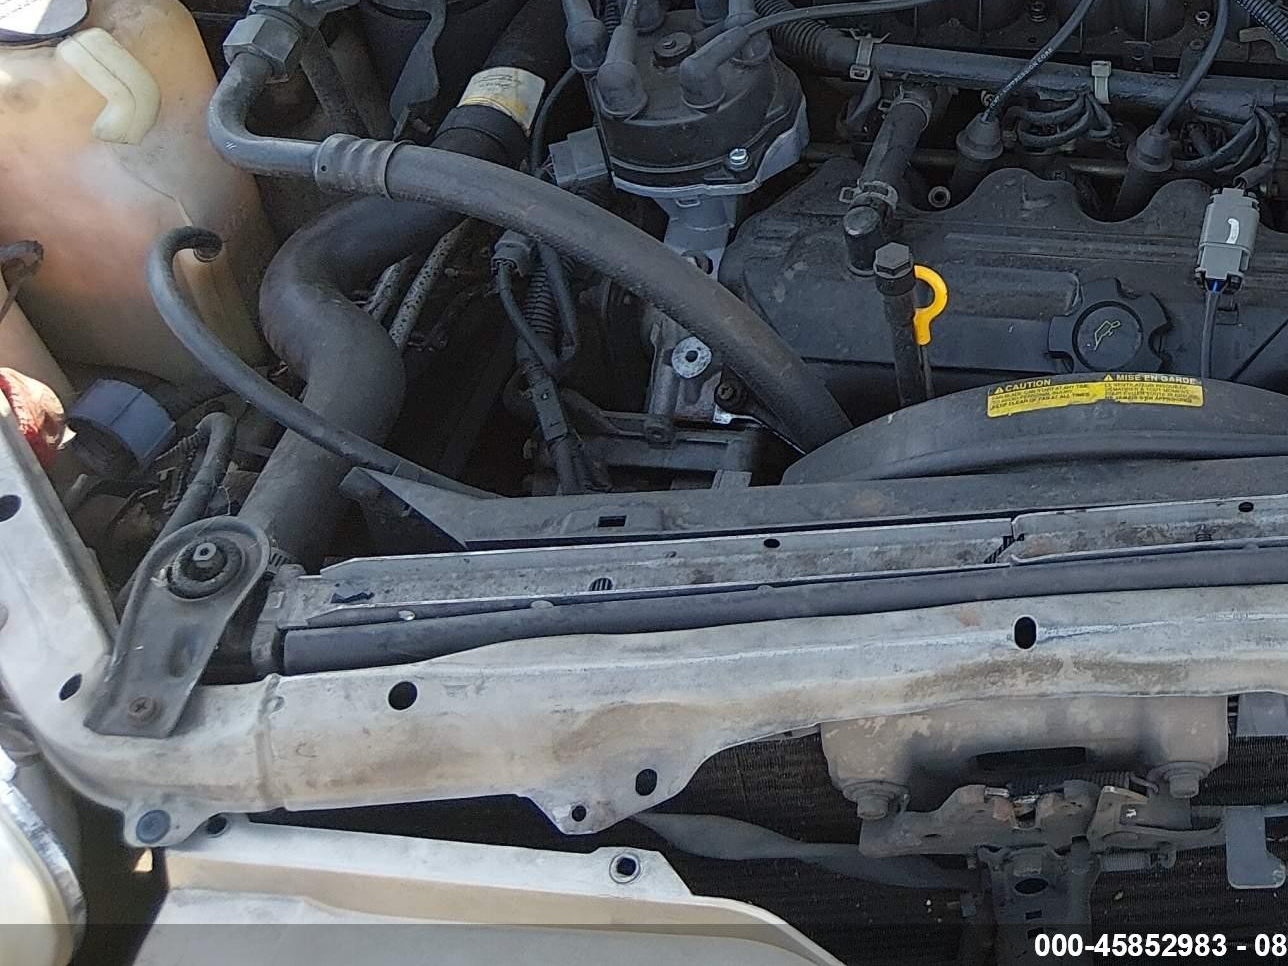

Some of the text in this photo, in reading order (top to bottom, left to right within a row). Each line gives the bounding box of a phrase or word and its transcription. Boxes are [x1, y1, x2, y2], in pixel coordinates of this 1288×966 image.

[1005, 379, 1051, 392] CAUTION
[1116, 374, 1197, 385] MISE EN GARDE
